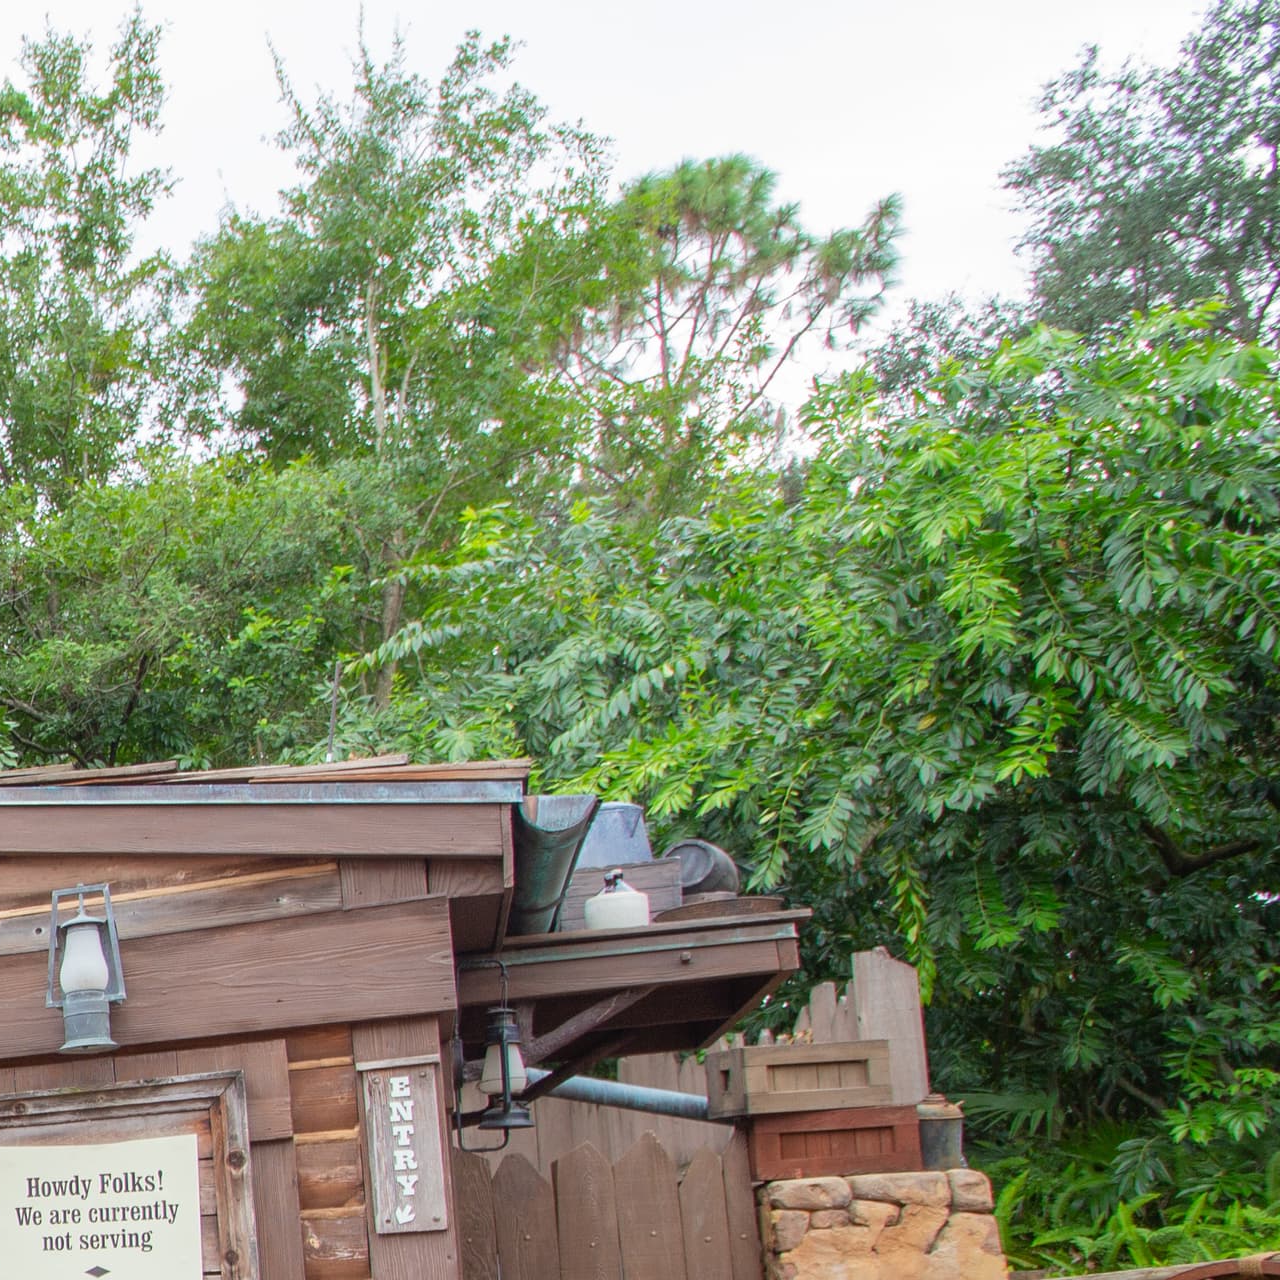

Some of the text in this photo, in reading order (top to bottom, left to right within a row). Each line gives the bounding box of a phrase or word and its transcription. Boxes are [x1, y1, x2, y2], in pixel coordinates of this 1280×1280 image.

[389, 1076, 419, 1197] ENTRY
[26, 1169, 164, 1201] Howdy Folks!
[15, 1199, 179, 1226] We are currently
[42, 1228, 153, 1253] not serving
